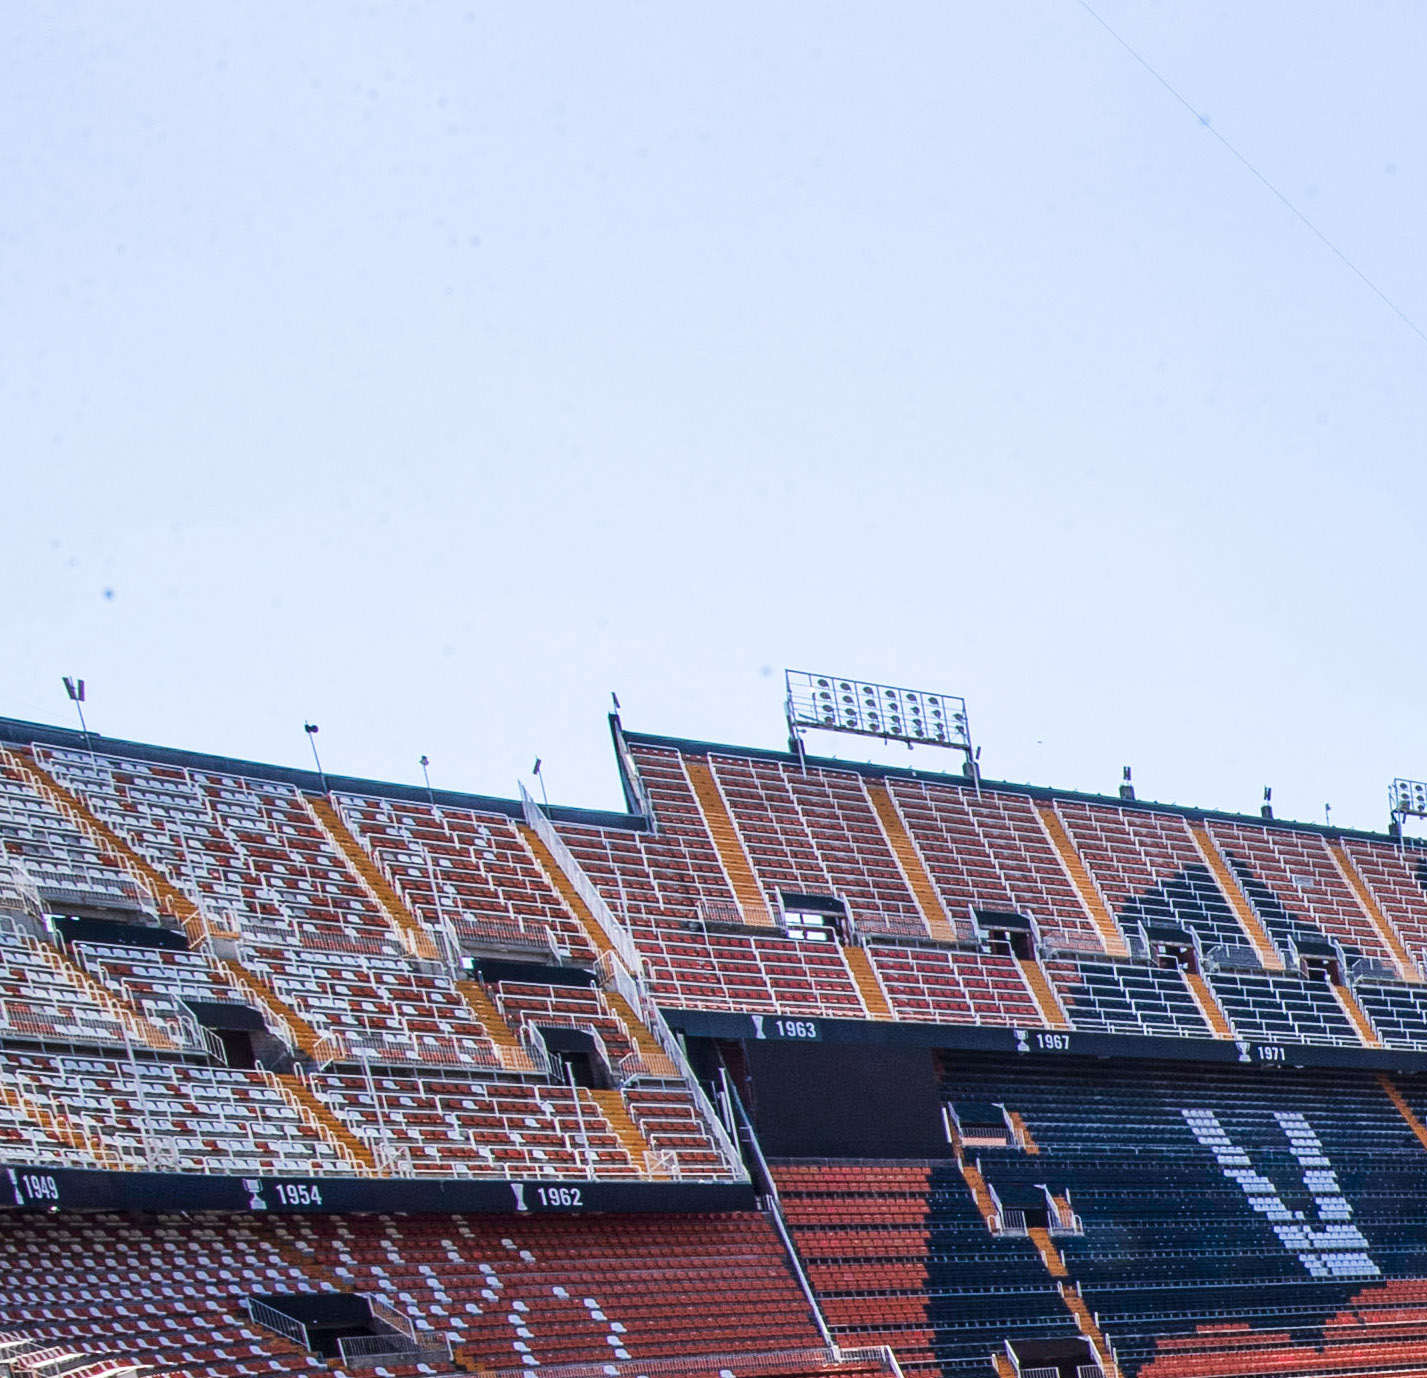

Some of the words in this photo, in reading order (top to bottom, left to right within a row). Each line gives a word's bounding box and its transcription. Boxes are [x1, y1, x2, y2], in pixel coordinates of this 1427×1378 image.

[775, 1020, 817, 1038] 1963
[1036, 1033, 1070, 1050] 1967
[1257, 1046, 1286, 1061] 1971
[22, 1174, 59, 1199] 1949
[275, 1184, 323, 1205] 1954
[537, 1187, 584, 1206] 1962
